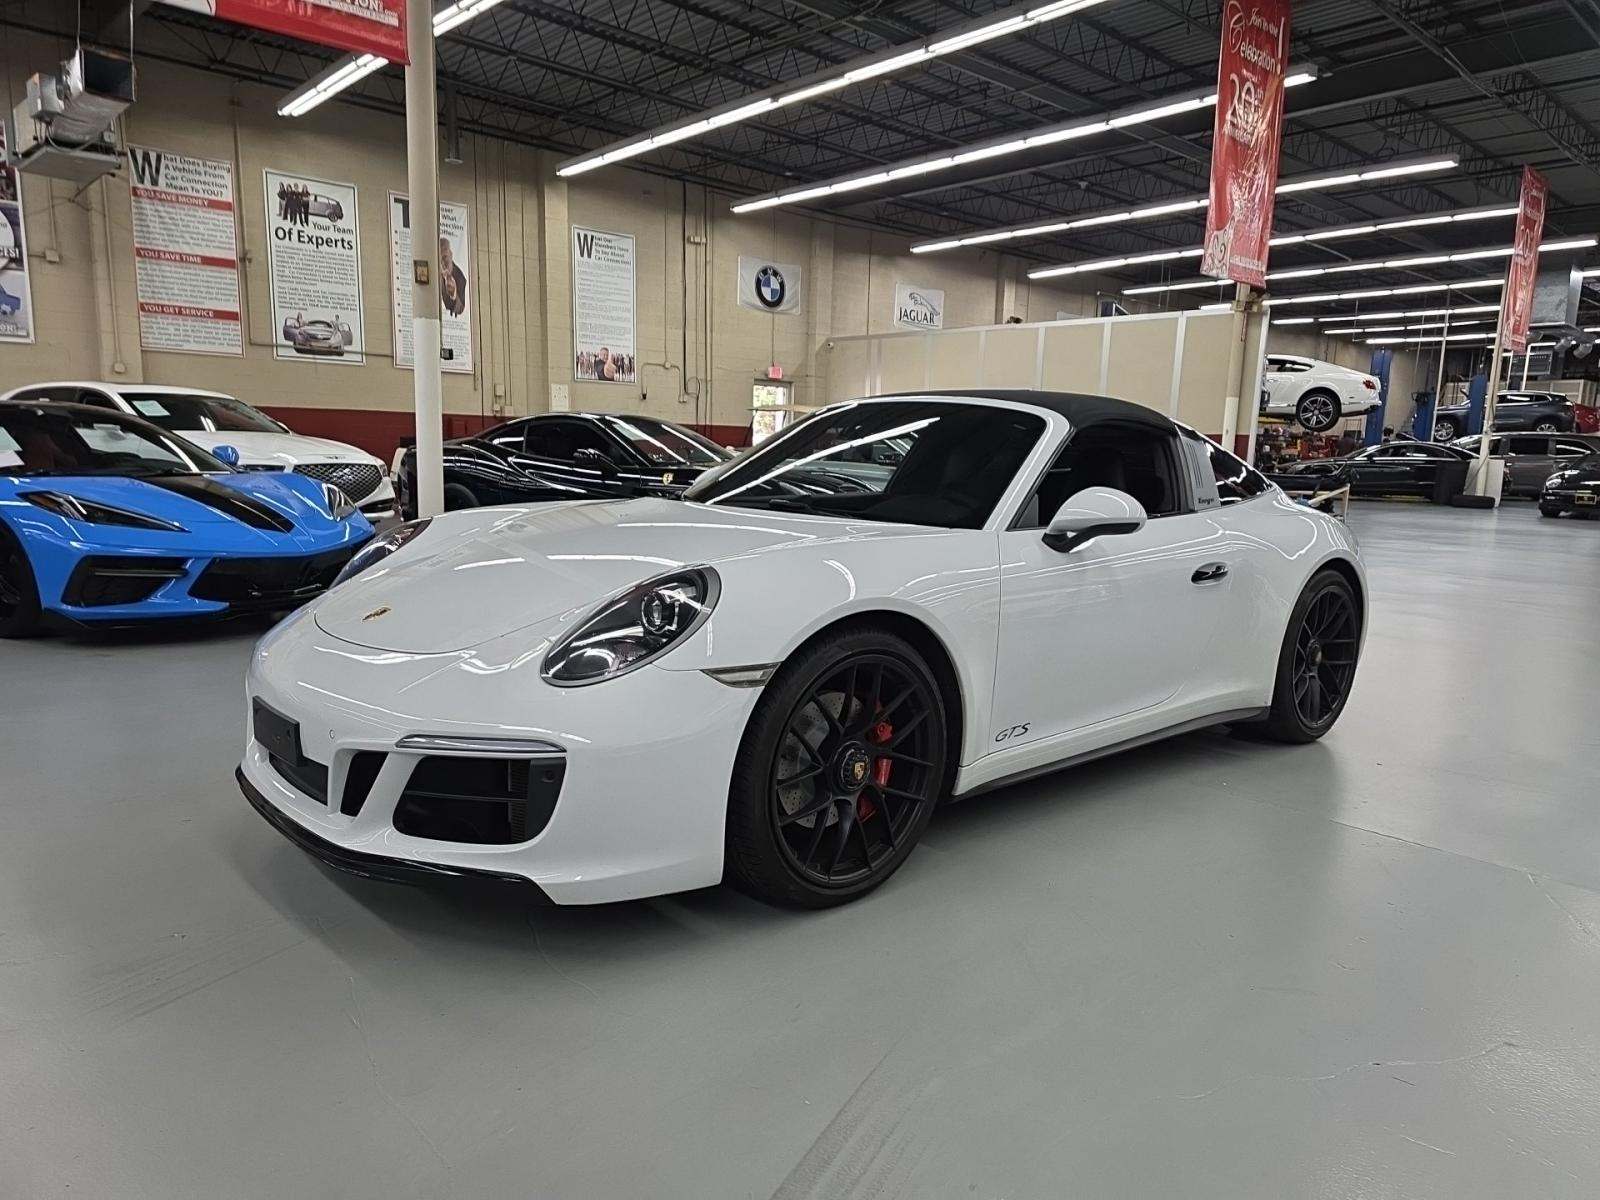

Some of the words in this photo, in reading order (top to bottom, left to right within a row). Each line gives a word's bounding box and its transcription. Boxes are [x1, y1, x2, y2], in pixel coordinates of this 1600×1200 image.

[172, 165, 202, 176] Vehicle
[203, 170, 225, 180] From
[179, 156, 201, 167] Does
[202, 160, 231, 174] Buying
[165, 173, 178, 181] Car
[181, 176, 228, 190] Connection
[165, 181, 189, 192] Mean
[191, 185, 201, 193] To
[202, 187, 223, 198] YOU?
[136, 189, 155, 199] YOU
[155, 191, 177, 202] SAVE
[178, 194, 209, 207] MONEY
[312, 221, 332, 232] Your
[332, 224, 354, 236] Team
[274, 226, 294, 241] Of
[297, 229, 354, 251] Experts
[140, 249, 159, 258] YOU
[159, 251, 181, 261] SAVE
[181, 254, 201, 264] TIME
[143, 303, 162, 313] YOU
[163, 305, 180, 315] GET
[181, 308, 214, 318] SERVICE
[899, 306, 936, 325] JAGUAR
[995, 722, 1031, 742] GTS
